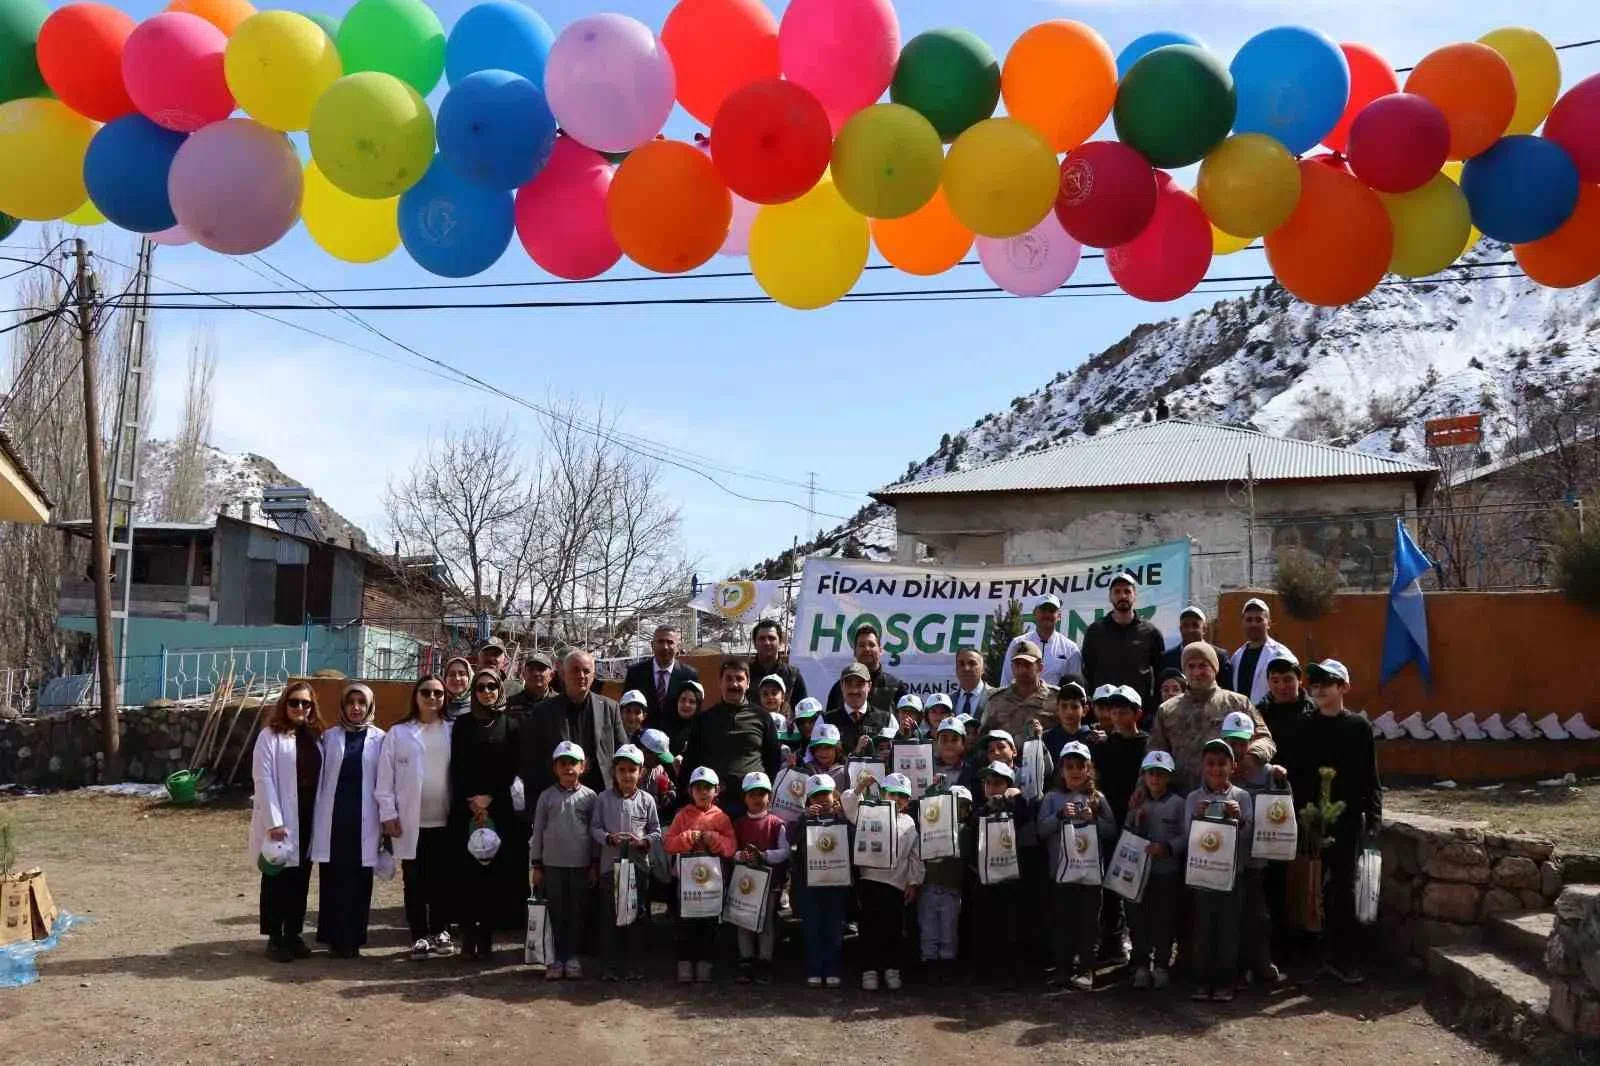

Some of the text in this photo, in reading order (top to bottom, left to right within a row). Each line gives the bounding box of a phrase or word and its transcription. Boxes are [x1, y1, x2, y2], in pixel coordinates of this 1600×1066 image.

[817, 563, 1162, 600] FİDAN DİKİM ETKİNLİĞNE
